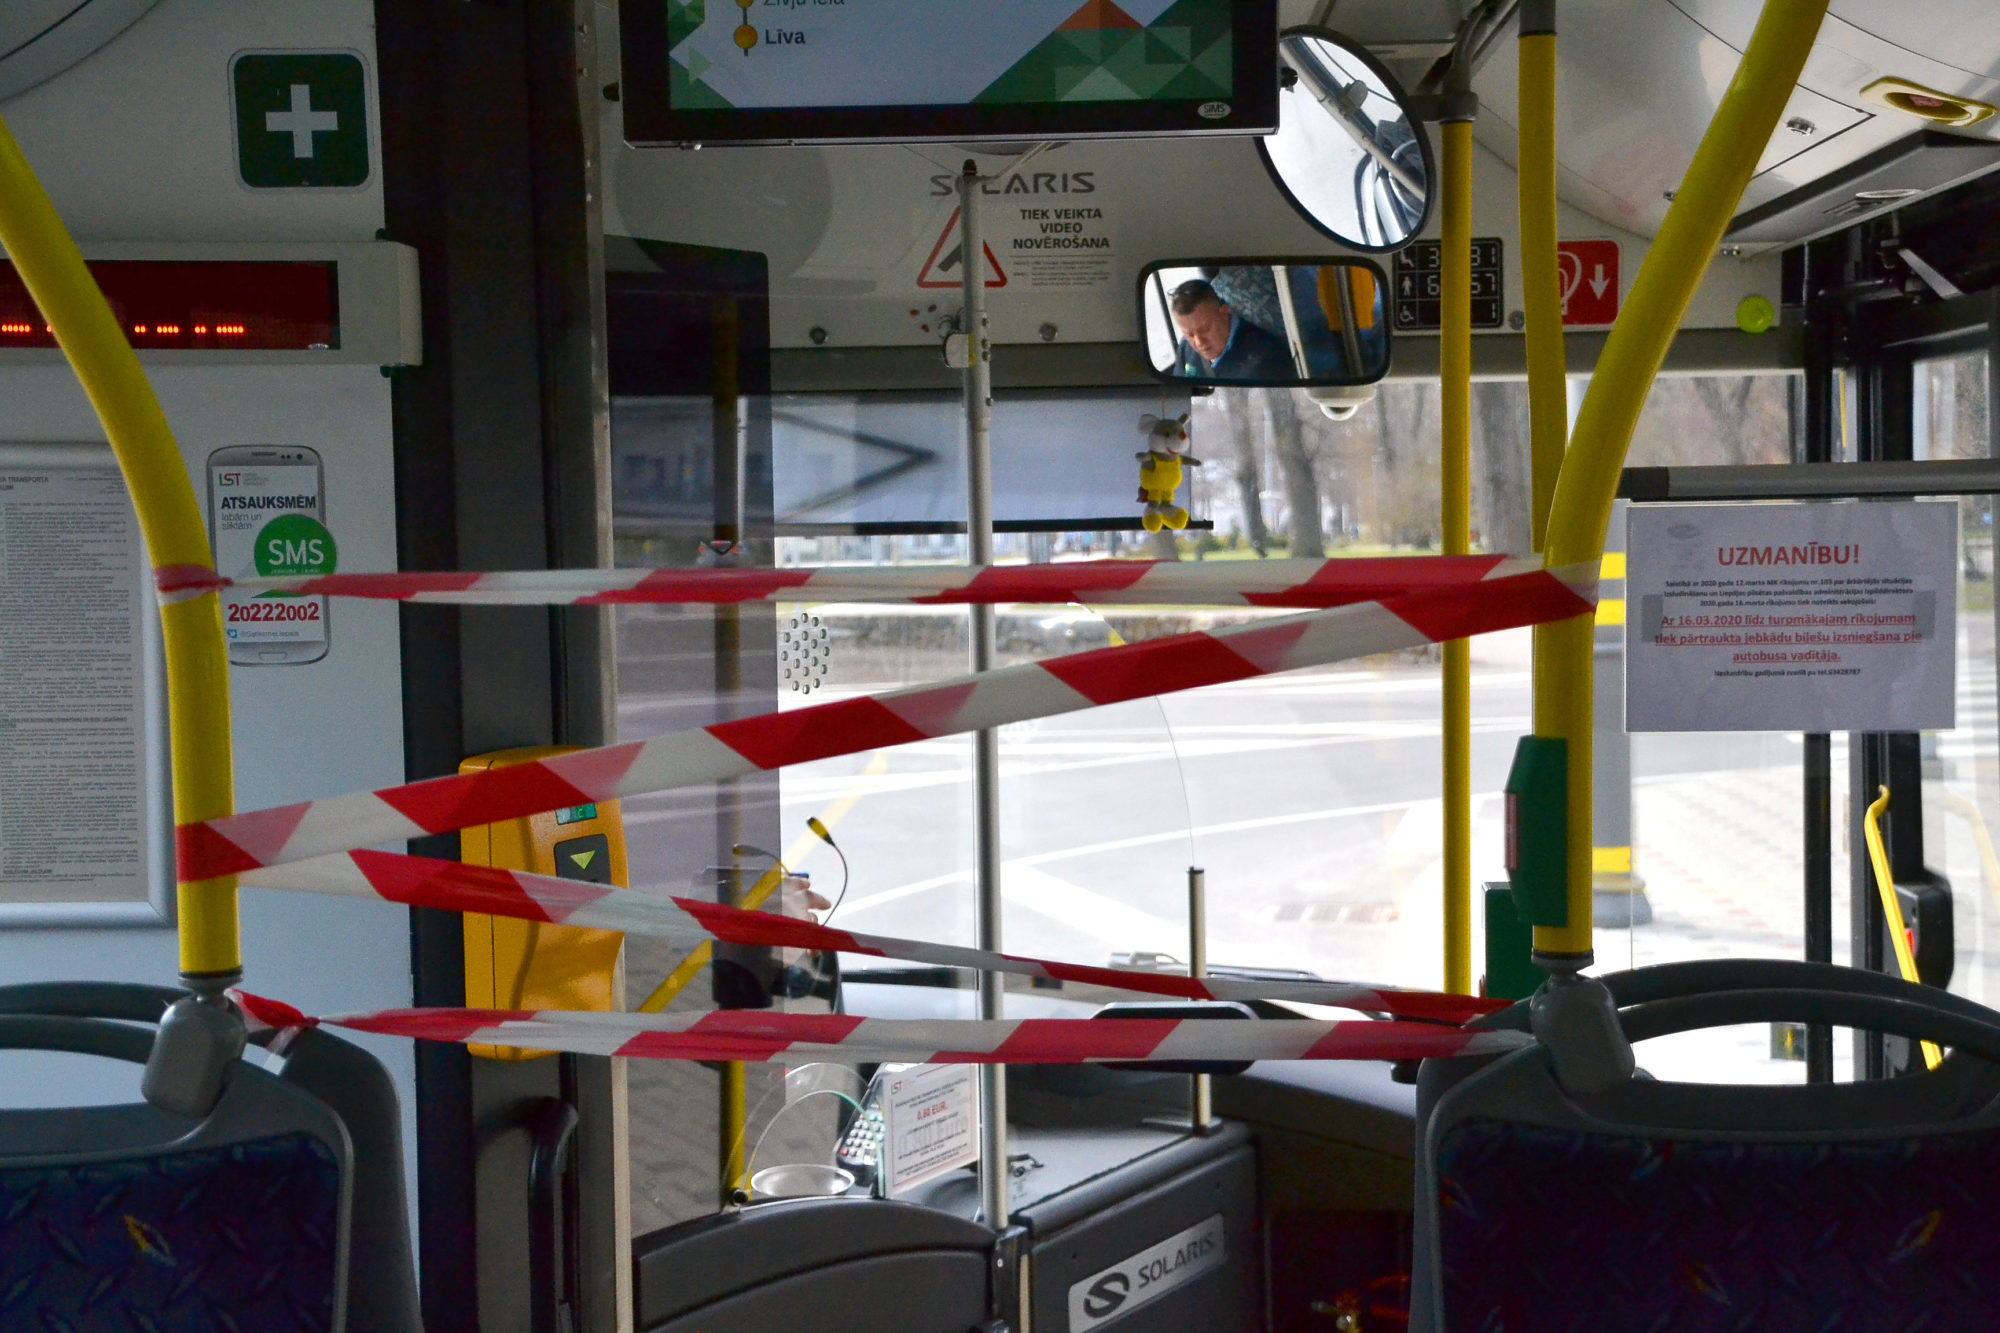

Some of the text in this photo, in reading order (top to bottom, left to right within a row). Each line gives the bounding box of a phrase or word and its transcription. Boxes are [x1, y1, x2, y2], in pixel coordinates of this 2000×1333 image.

[765, 28, 806, 44] Līva
[1020, 208, 1103, 220] TIEK VEIKTA
[1040, 222, 1083, 234] VIDEO
[1013, 235, 1111, 249] NOVĒROŠANA
[219, 472, 241, 486] LST
[221, 495, 317, 509] ATSAUKSMĒM
[221, 511, 262, 521] labām un
[268, 539, 325, 566] SMS
[1718, 541, 1860, 566] UZMANĪBU!
[228, 602, 320, 622] 20222002
[1661, 615, 1674, 626] Ar
[1678, 615, 1743, 626] 16.03.2020
[1744, 614, 1765, 625] līdz
[1768, 613, 1848, 626] turpmākajam
[1679, 632, 1742, 646] pārtraukta
[1744, 631, 1792, 645] jebkādu
[1795, 631, 1830, 644] biļešu
[1832, 630, 1901, 644] izsniegšana
[1903, 629, 1923, 643] pie
[1732, 650, 1787, 662] autobusa
[1138, 1232, 1215, 1288] SOLARIS
